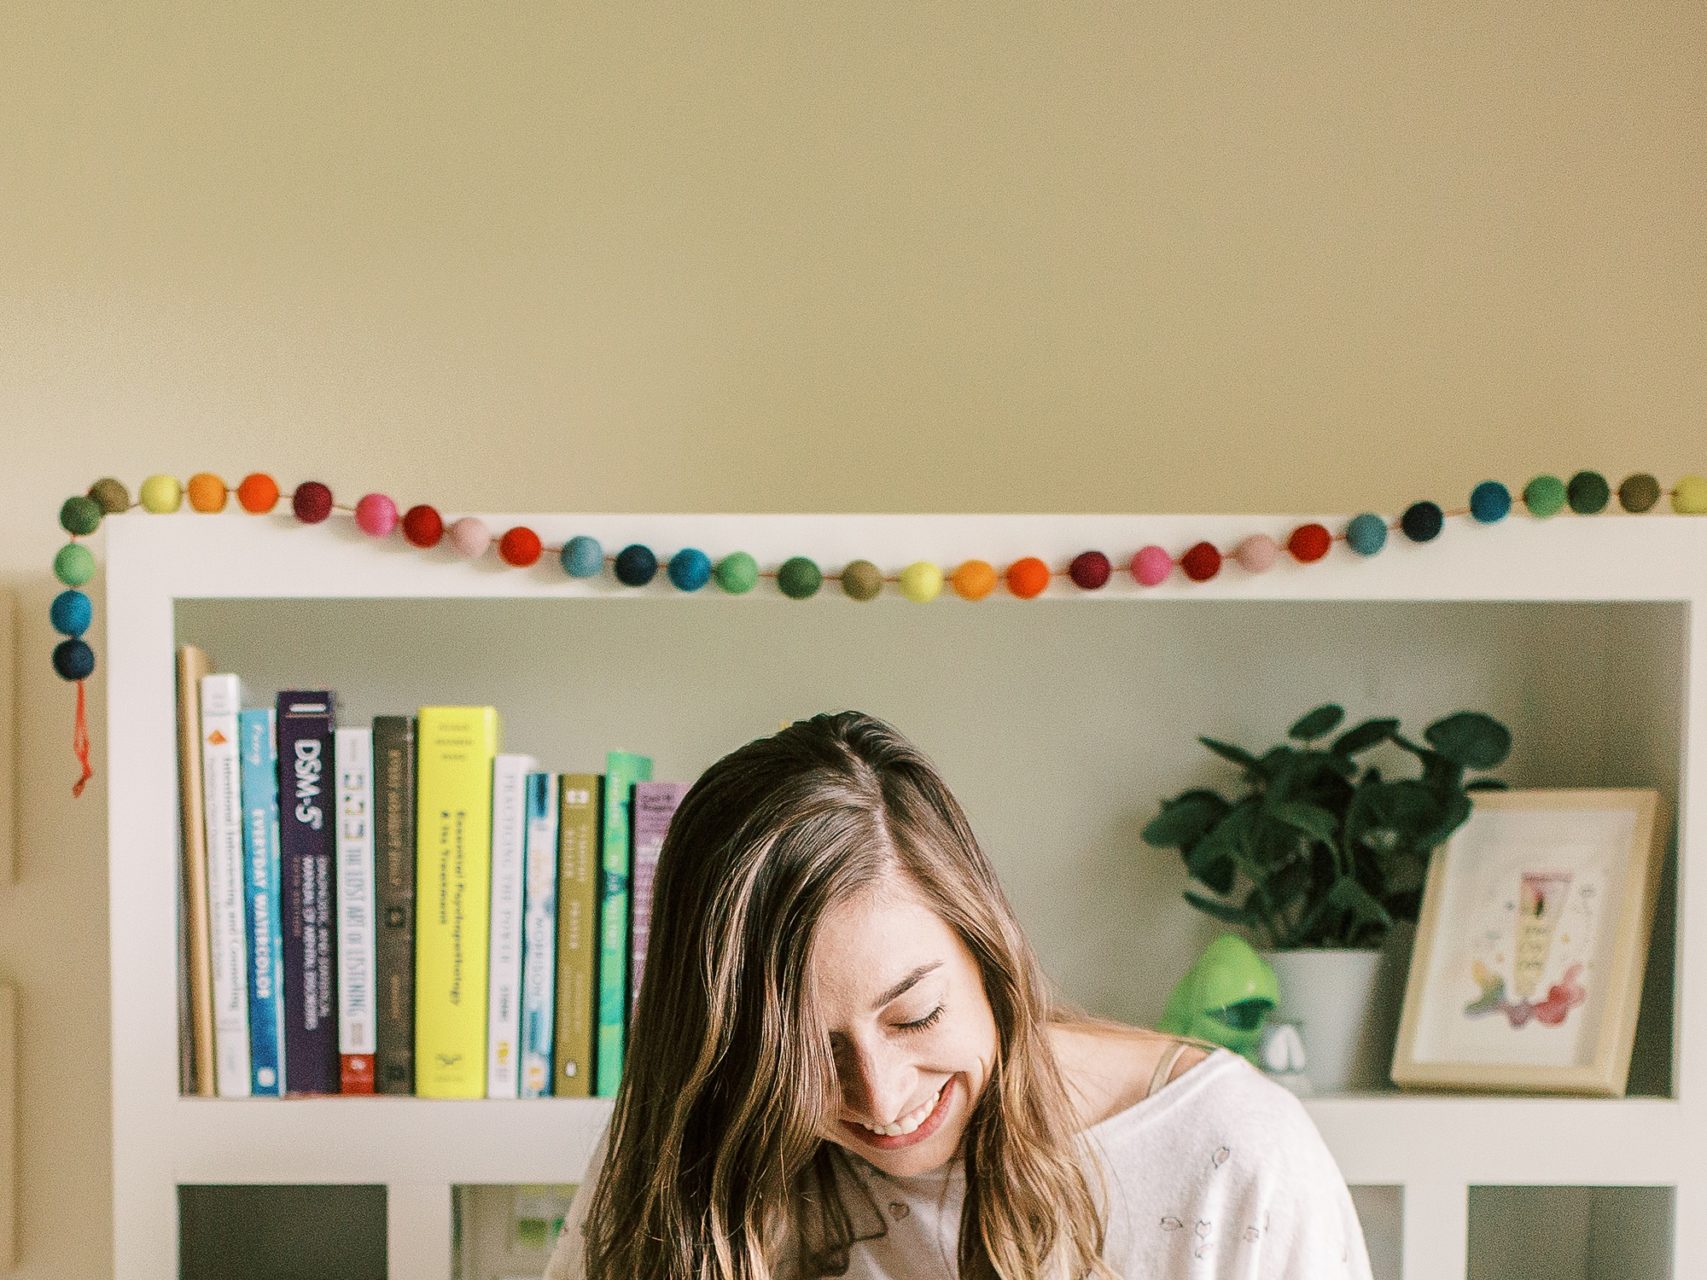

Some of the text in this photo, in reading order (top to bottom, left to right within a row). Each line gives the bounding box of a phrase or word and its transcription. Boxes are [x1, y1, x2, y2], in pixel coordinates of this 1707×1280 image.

[347, 871, 366, 902] LOST
[348, 848, 362, 867] THE
[439, 850, 451, 925] Treatment
[252, 808, 270, 999] EVERYDAY WATERCOLOR
[316, 855, 332, 1018] DIAGNOSTIC AND STATISTICAL
[347, 906, 366, 929] ART
[449, 811, 467, 1007] Essential Psychopathology
[302, 855, 319, 1031] MANUAL OF MENTAL DISORDERS
[346, 950, 367, 1018] LISTENING
